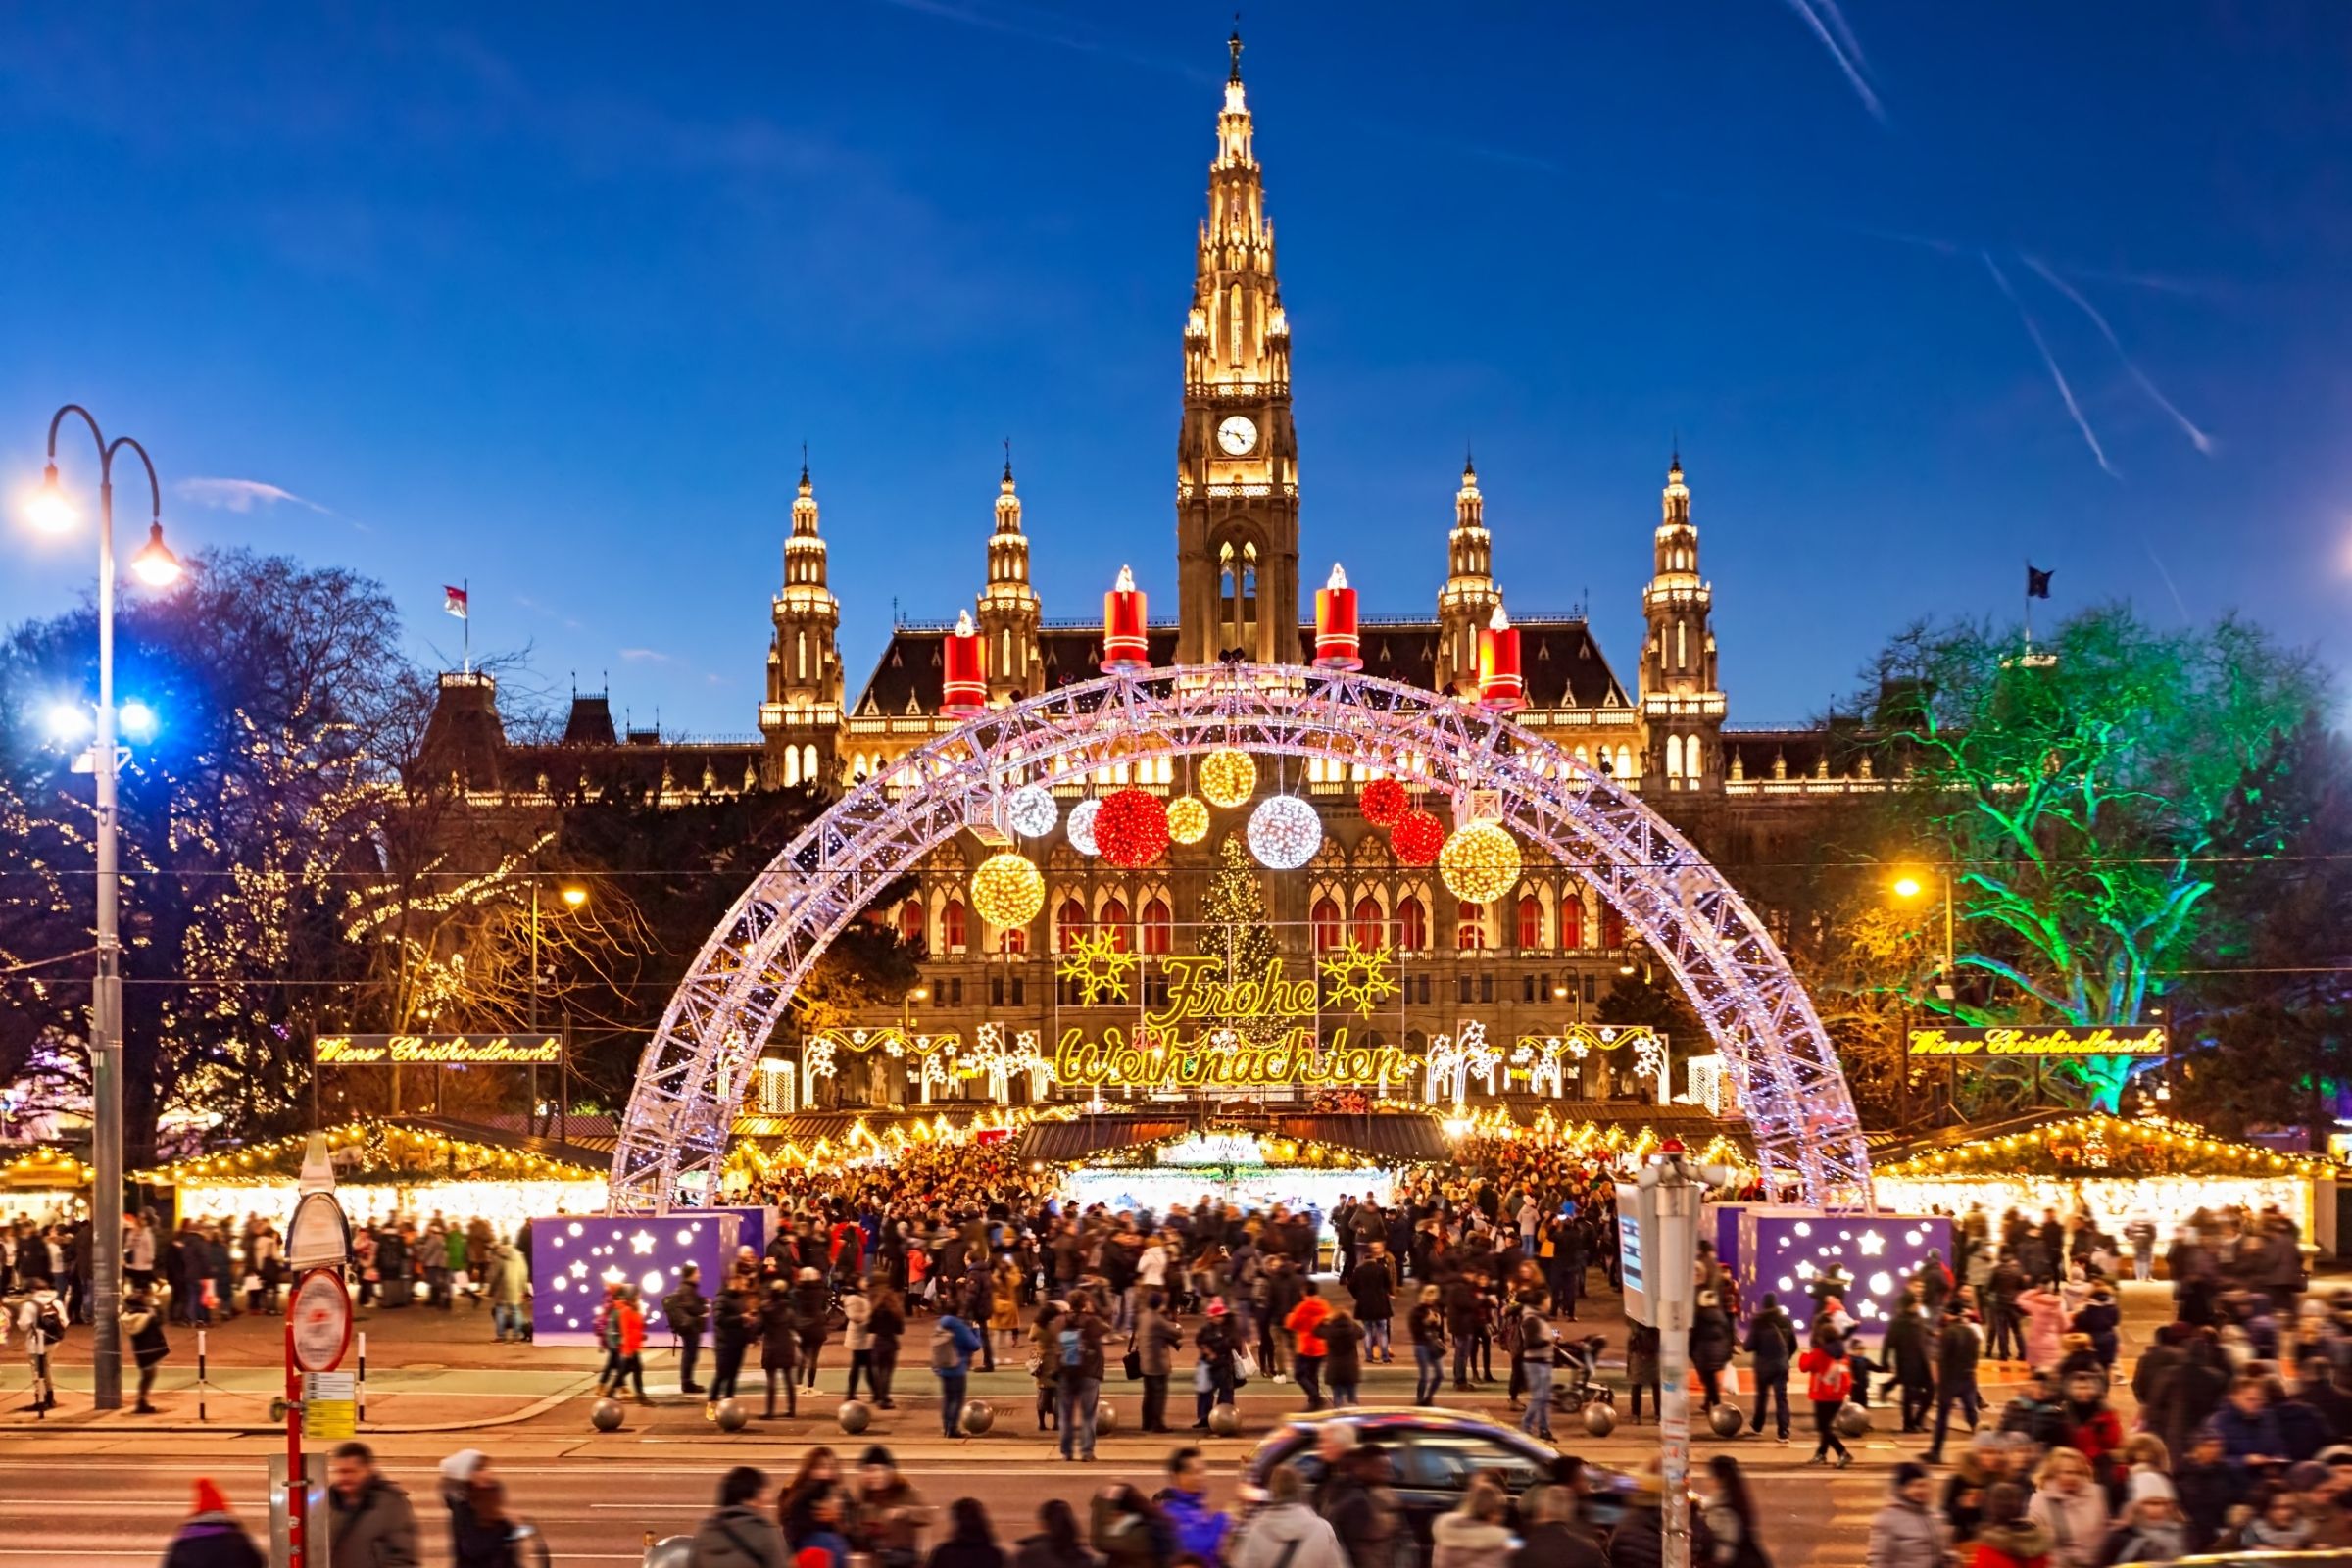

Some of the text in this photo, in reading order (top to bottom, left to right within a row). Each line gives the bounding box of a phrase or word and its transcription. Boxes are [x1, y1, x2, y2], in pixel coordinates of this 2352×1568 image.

[1145, 957, 1318, 1028] Frohe
[317, 1036, 562, 1061] Wiener Christkindlmarkt
[1055, 1027, 1406, 1086] Weihnachten
[1909, 1028, 2167, 1054] Wiener Christkindlmarkt
